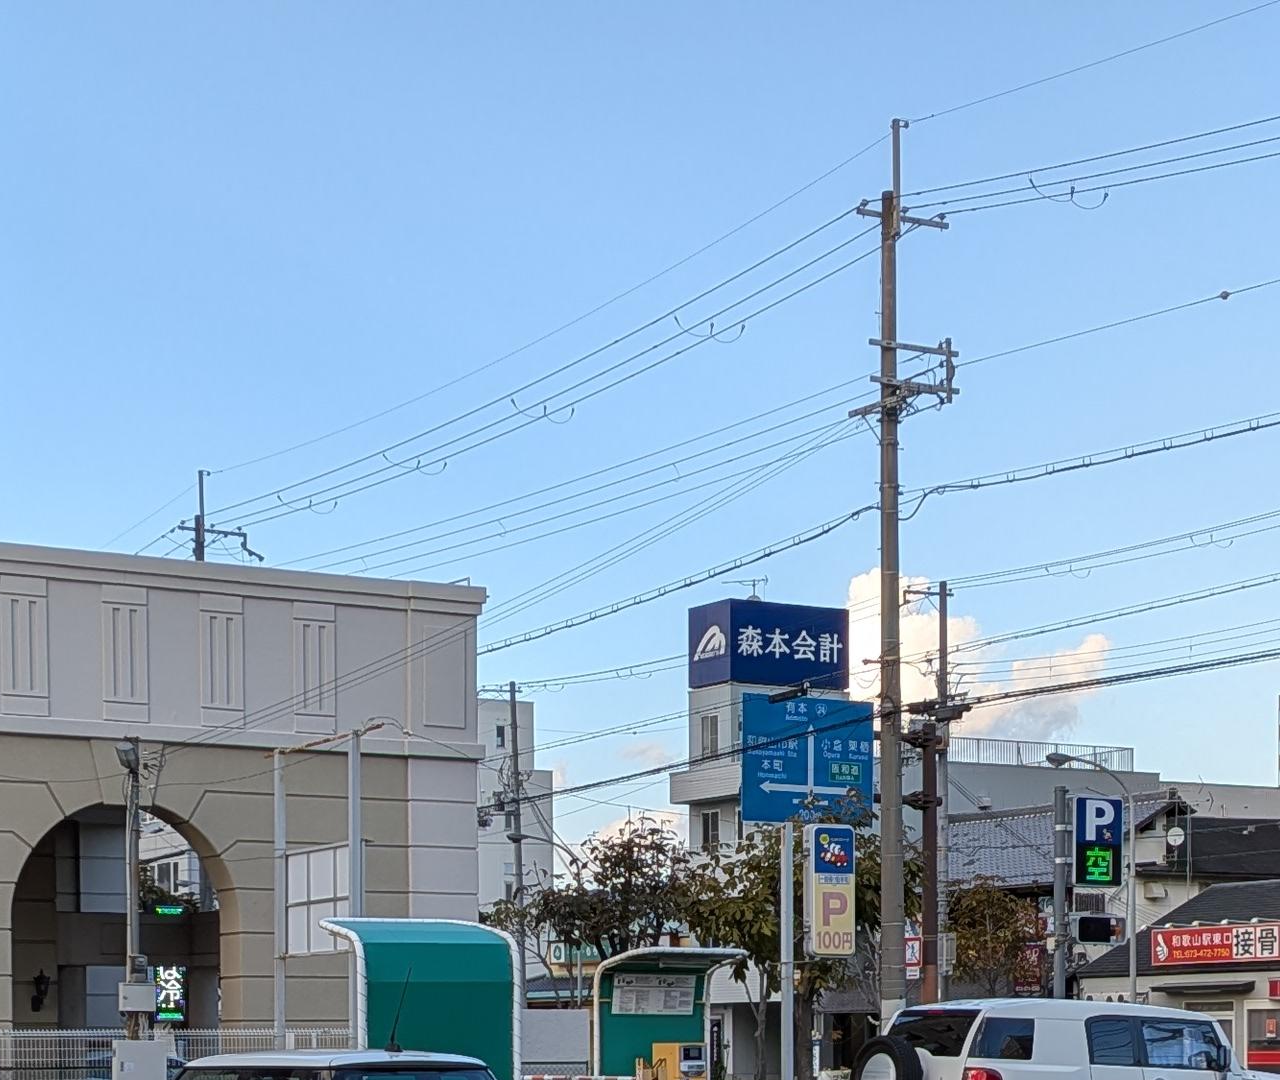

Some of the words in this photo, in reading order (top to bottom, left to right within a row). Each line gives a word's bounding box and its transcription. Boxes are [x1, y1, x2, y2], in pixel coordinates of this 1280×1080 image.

[737, 625, 843, 664] 森本会計
[1086, 800, 1115, 841] P
[1086, 847, 1112, 880] 空
[822, 891, 848, 927] P
[816, 931, 852, 950] 100円
[1171, 932, 1232, 947] 和歌山駅東口
